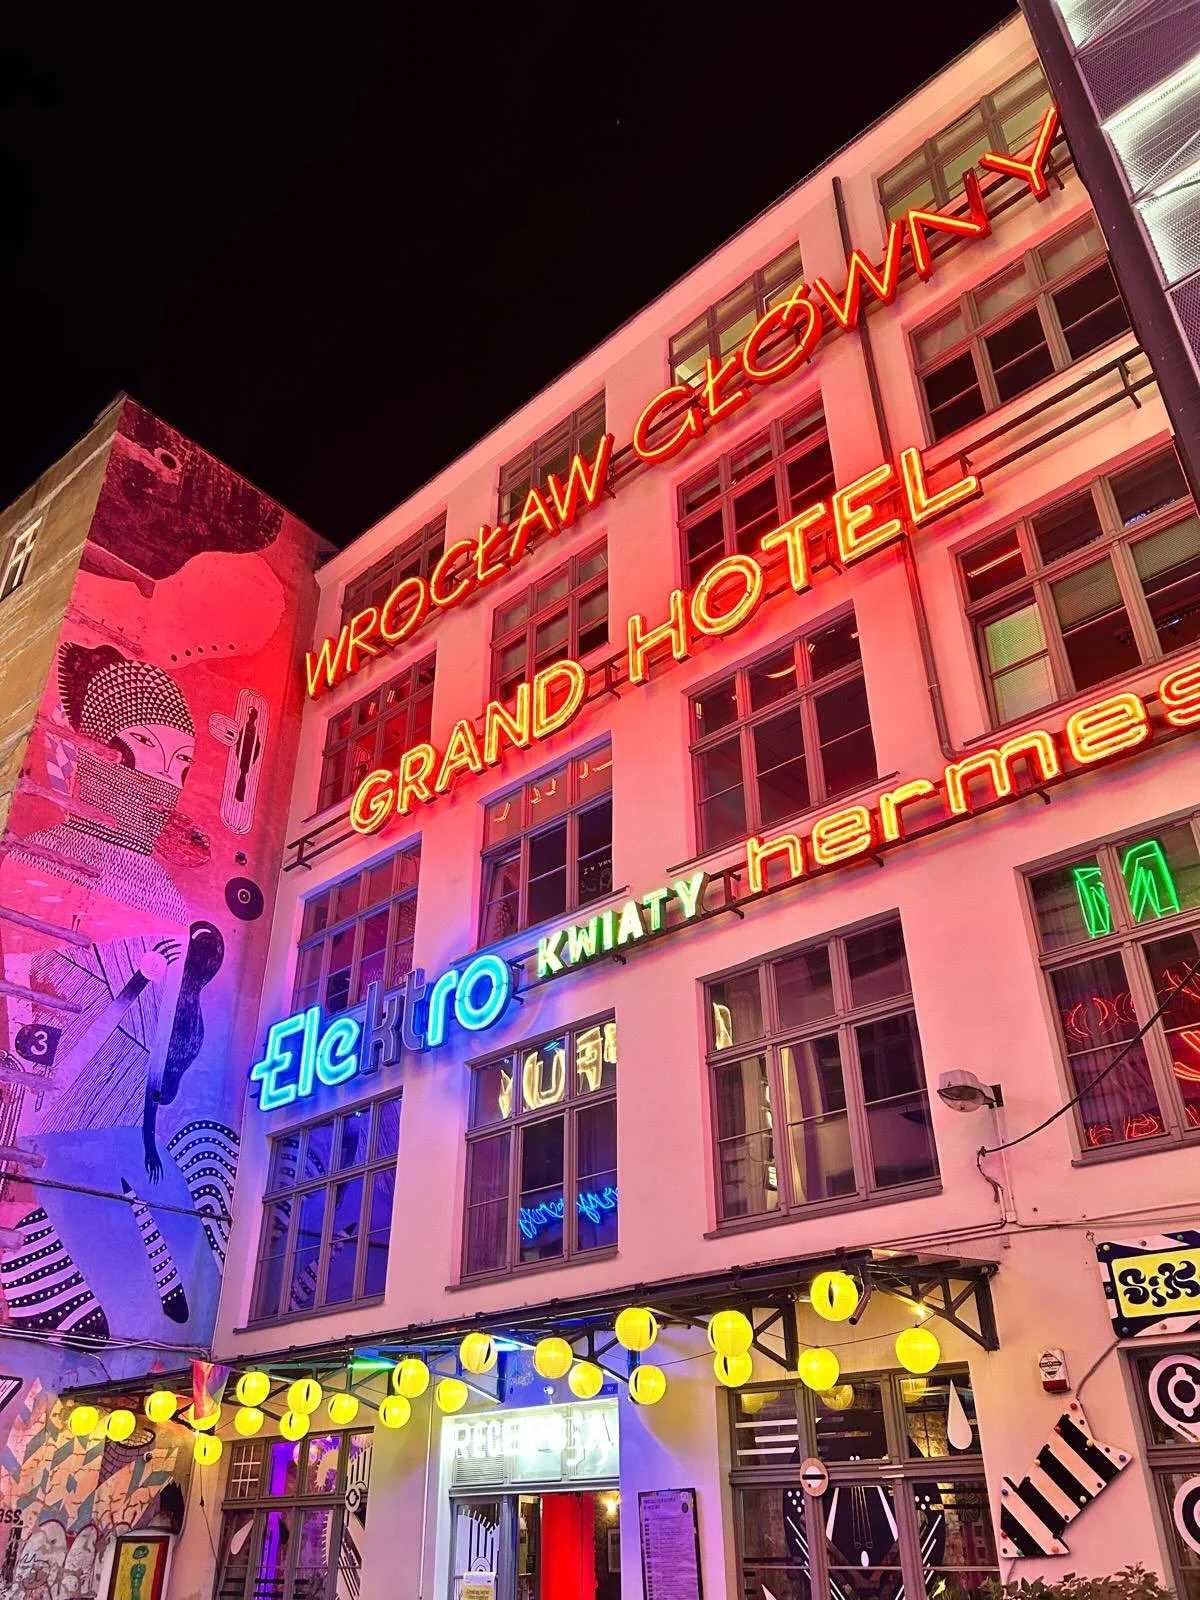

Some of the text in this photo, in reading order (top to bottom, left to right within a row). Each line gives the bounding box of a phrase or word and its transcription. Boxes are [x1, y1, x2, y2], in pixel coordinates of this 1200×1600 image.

[305, 104, 1061, 699] WROCŁAW GŁÓWNY
[349, 446, 984, 836] GRAND HOTEL
[537, 872, 711, 978] KWIATY
[30, 1031, 49, 1055] 3
[250, 953, 514, 1112] Elektro
